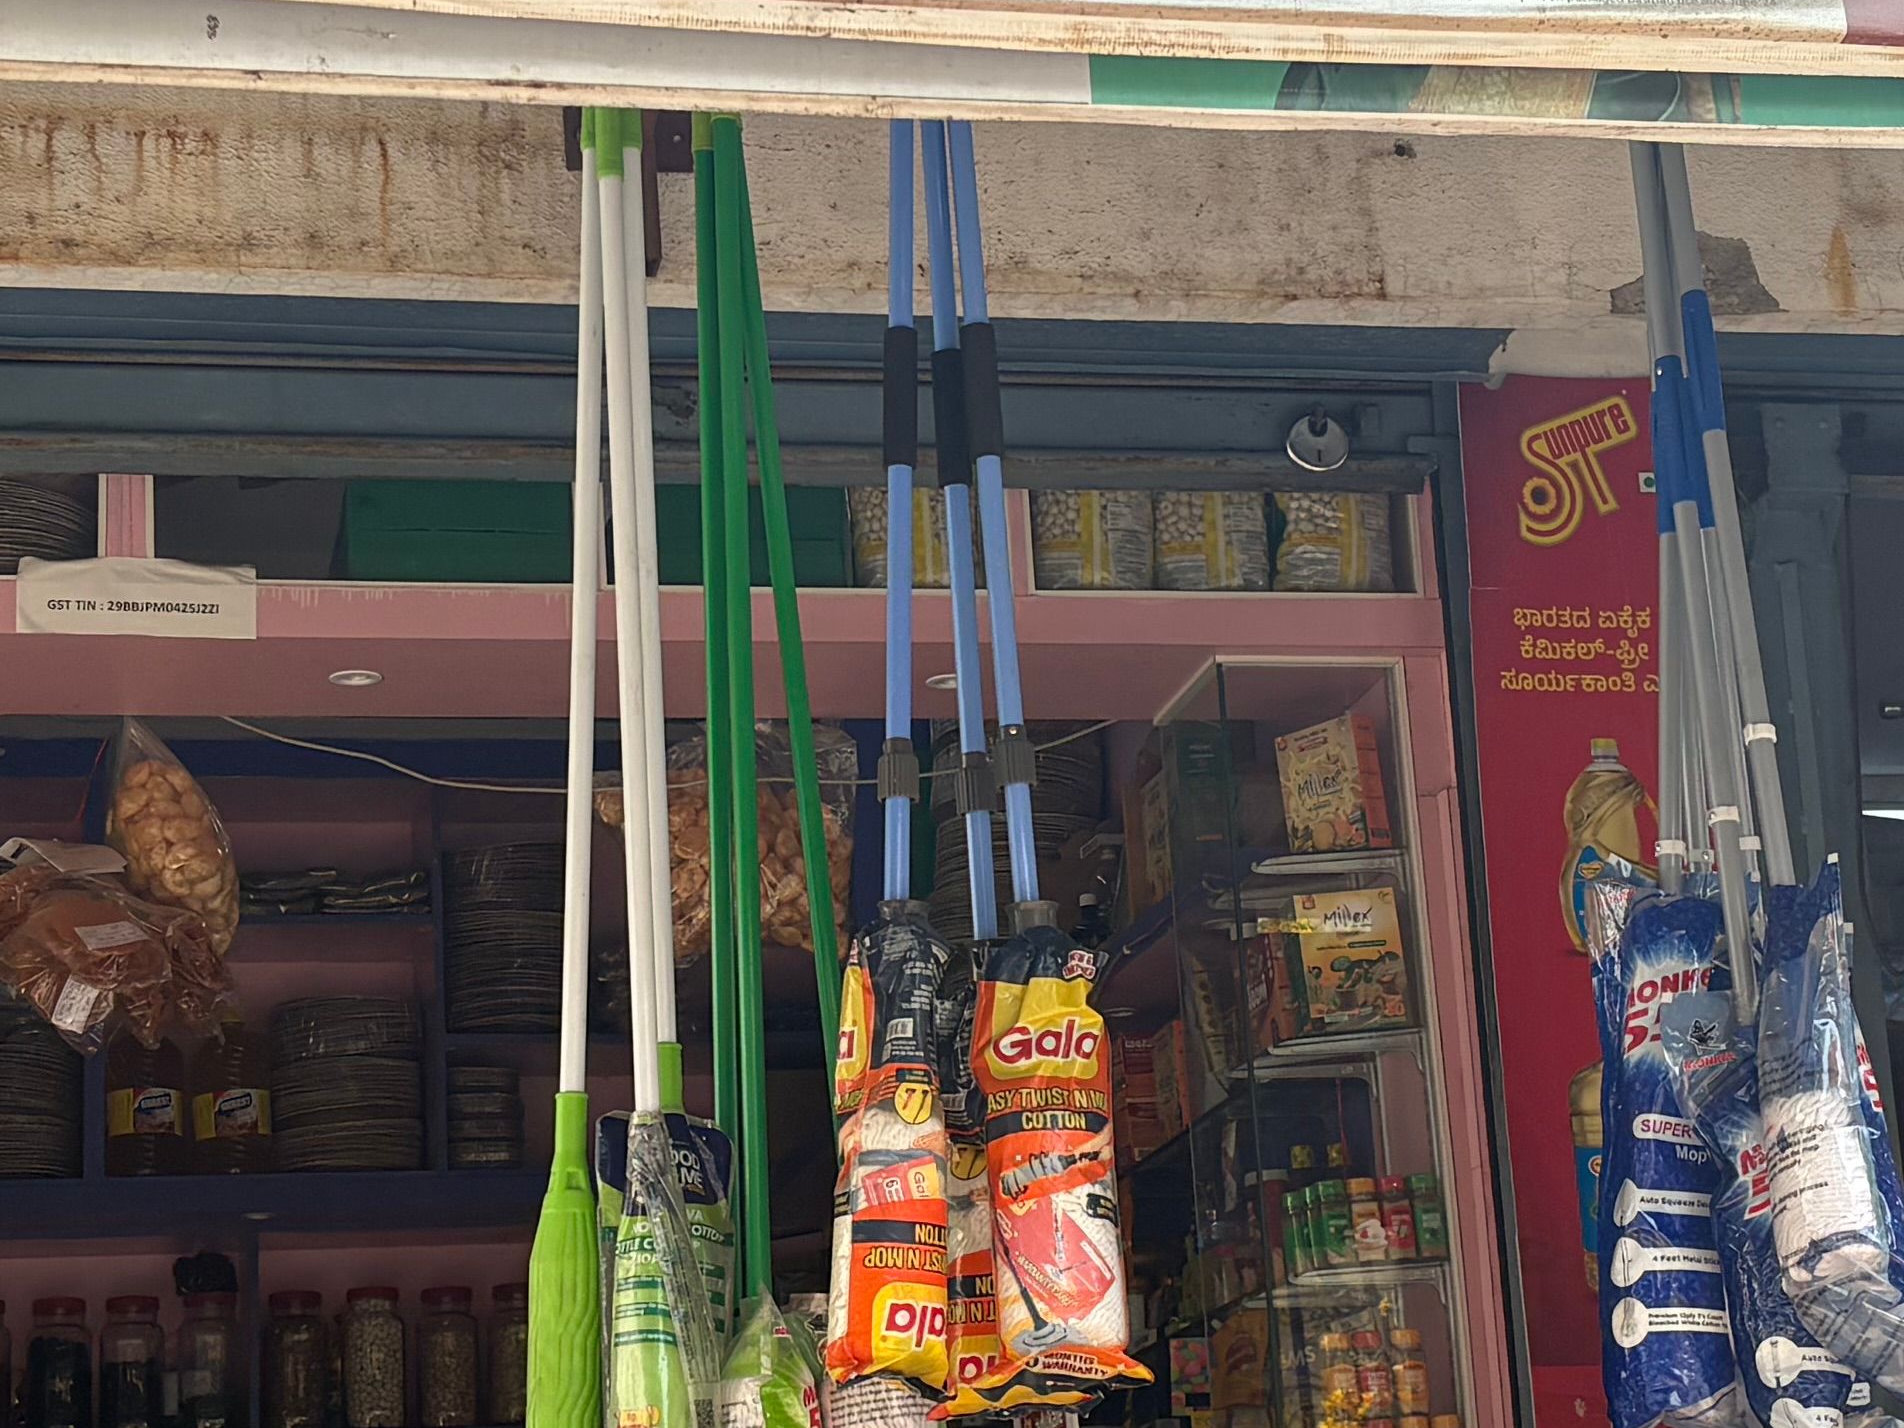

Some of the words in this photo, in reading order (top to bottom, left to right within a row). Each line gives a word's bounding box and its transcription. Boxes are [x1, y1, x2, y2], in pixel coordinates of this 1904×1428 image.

[47, 599, 71, 611] GST
[75, 599, 97, 612] TIN
[1513, 606, 1591, 630] ಭಾರತದ
[1598, 607, 1652, 640] ಏಕೈಕ
[1520, 637, 1650, 669] ಕೆಮಿಕಲ್-ಫ್ರೀ
[1500, 669, 1635, 693] ಸೂರ್ಯಕಾಂತಿ
[992, 1016, 1102, 1066] Gala
[986, 1089, 1018, 1115] ASY
[1018, 1087, 1073, 1109] TWIST
[1021, 1110, 1087, 1132] COTTON
[1640, 1118, 1693, 1139] SUPER
[1675, 1143, 1708, 1165] Mop
[864, 1246, 900, 1270] MOP
[1660, 1253, 1682, 1264] Feet
